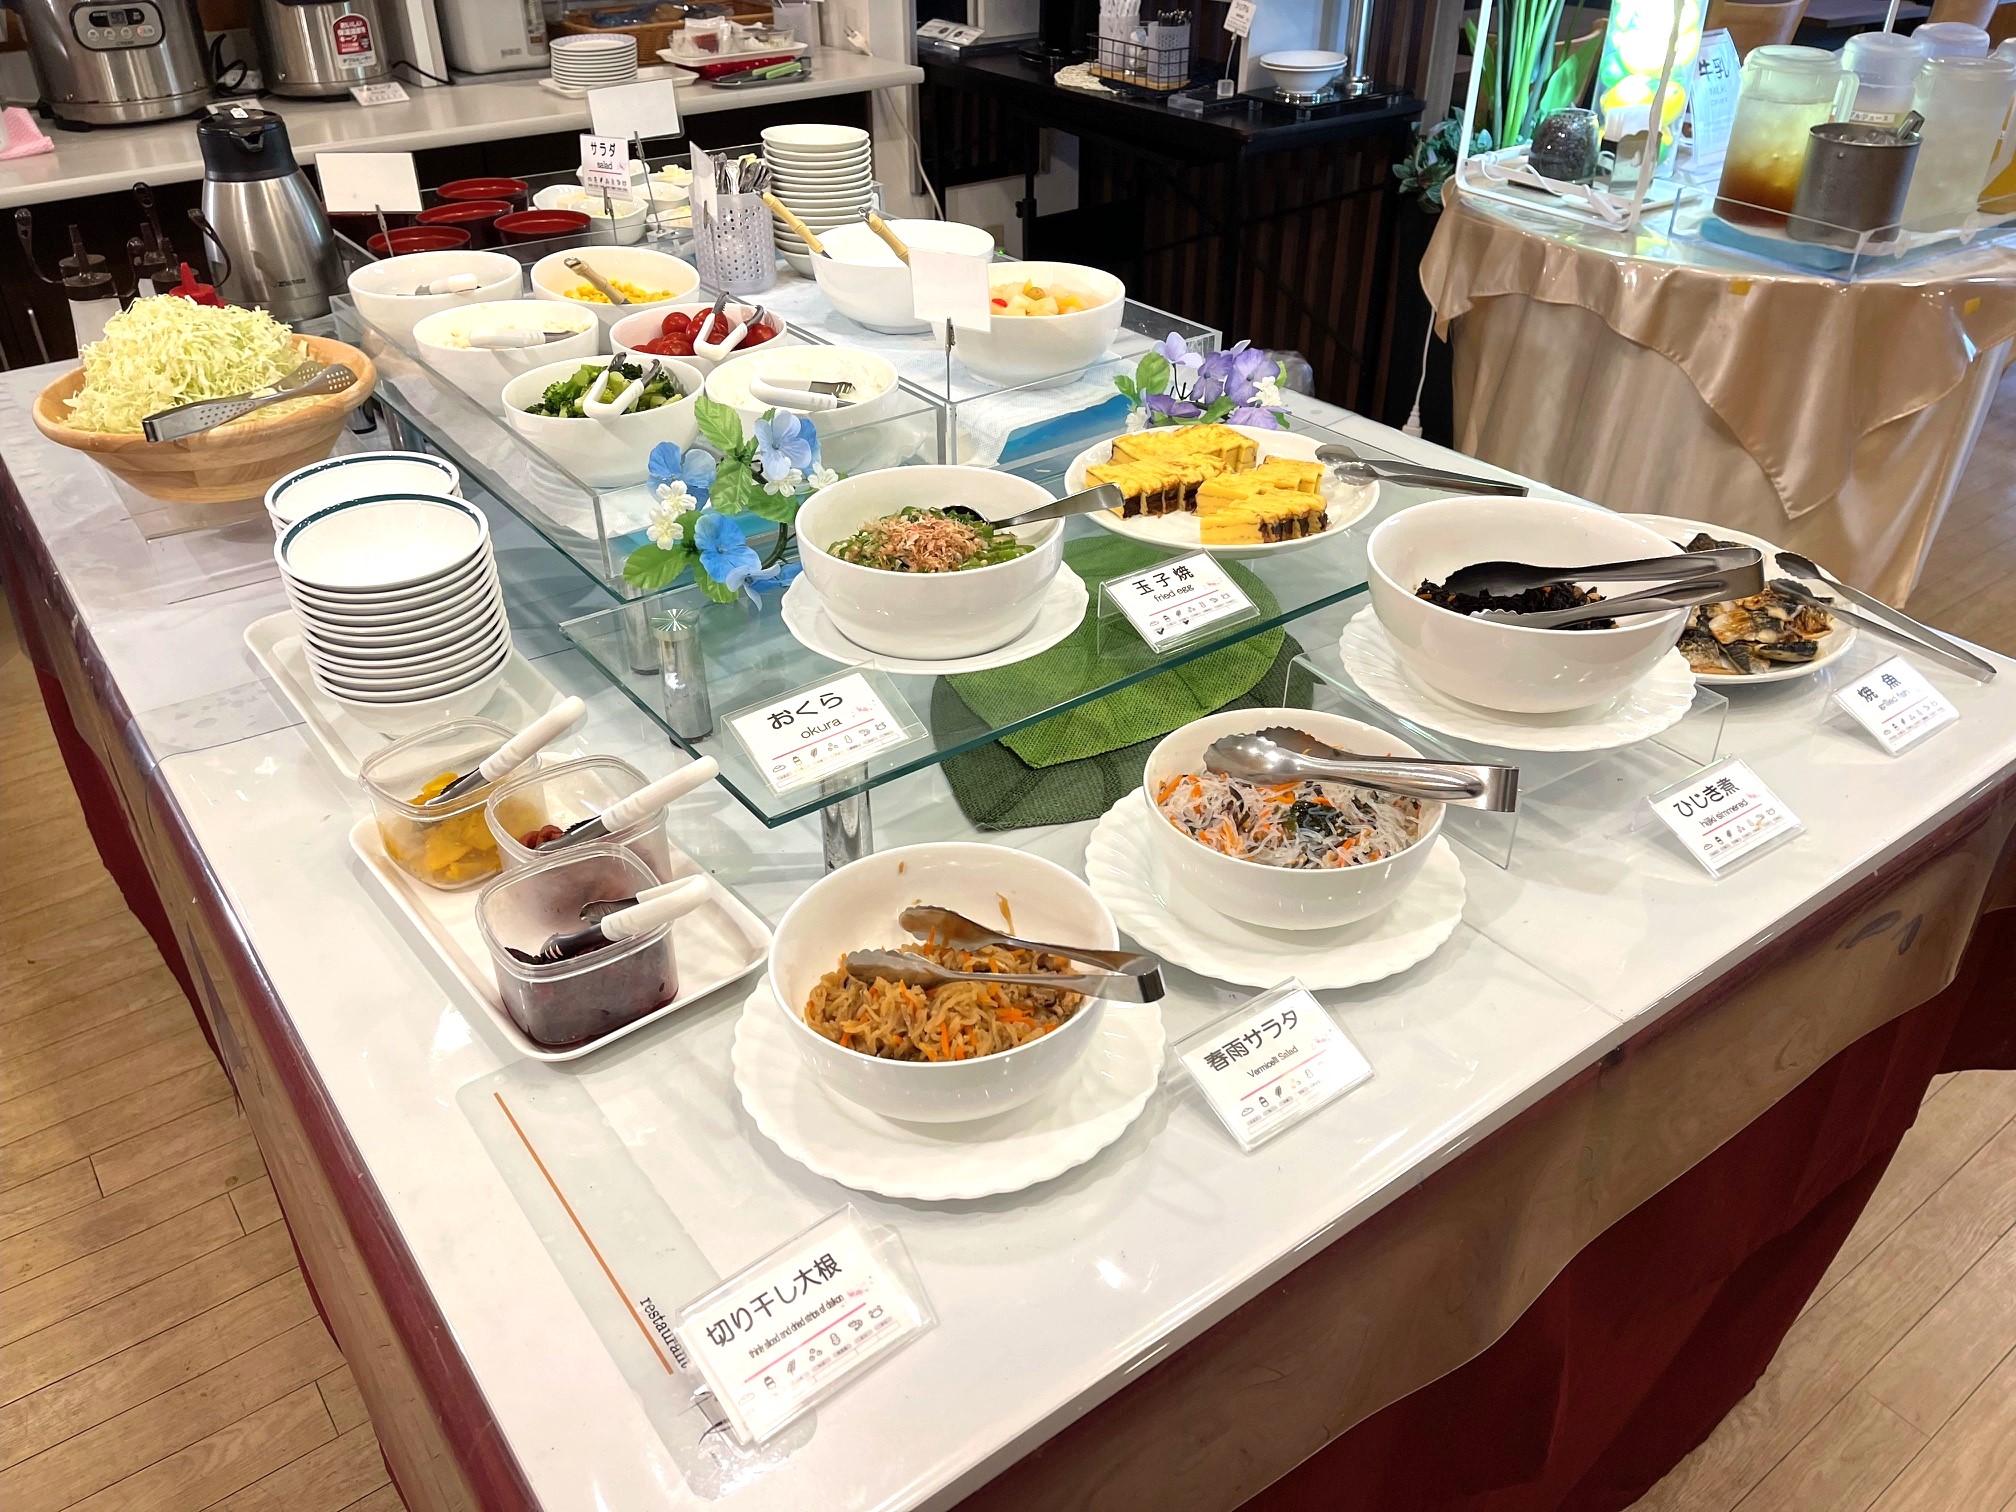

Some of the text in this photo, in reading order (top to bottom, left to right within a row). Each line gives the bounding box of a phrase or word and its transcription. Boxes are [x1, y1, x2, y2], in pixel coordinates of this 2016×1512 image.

[1699, 57, 1730, 81] 牛乳
[590, 142, 616, 157] サラダ
[596, 160, 613, 170] salad
[1132, 565, 1195, 596] 玉子焼
[1153, 584, 1195, 602] fried egg
[766, 692, 843, 730] おくら
[800, 718, 843, 739] okura
[1673, 777, 1740, 818] ひじき煮
[1278, 1045, 1299, 1061] Salad
[706, 1253, 843, 1348] 切り干し大根
